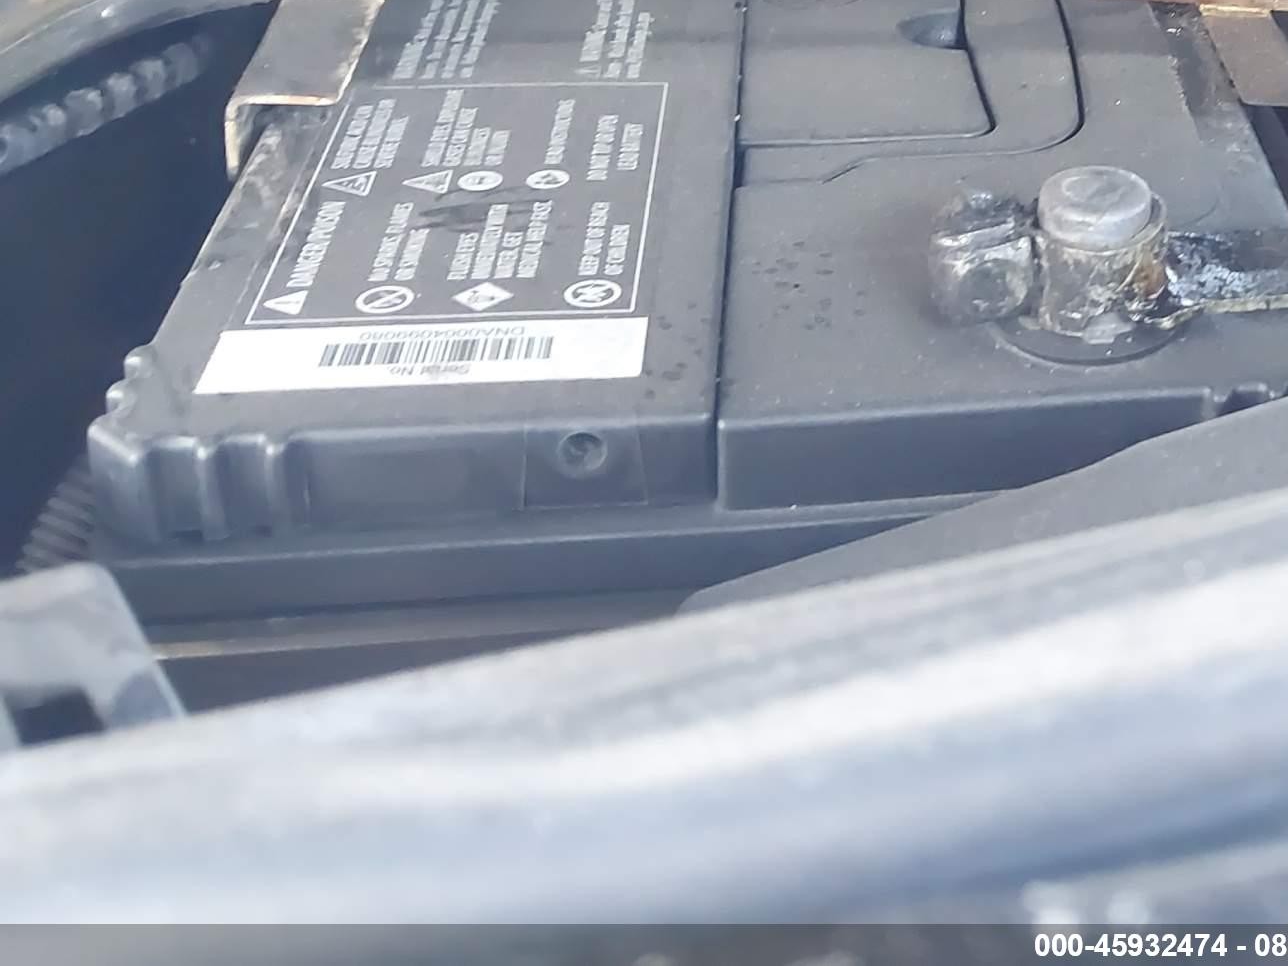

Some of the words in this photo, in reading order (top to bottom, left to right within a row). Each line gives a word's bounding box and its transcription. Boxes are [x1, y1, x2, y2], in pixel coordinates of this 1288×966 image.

[385, 202, 414, 234] FLAMES
[588, 202, 609, 226] REACH
[455, 233, 479, 252] EYES
[525, 222, 548, 241] HELP
[582, 239, 602, 254] OUT
[606, 224, 630, 264] CHILDREN
[446, 253, 472, 280] FLUSH
[515, 242, 543, 278] MEDICAL
[578, 255, 599, 275] KEEP
[421, 363, 471, 376] Serial
